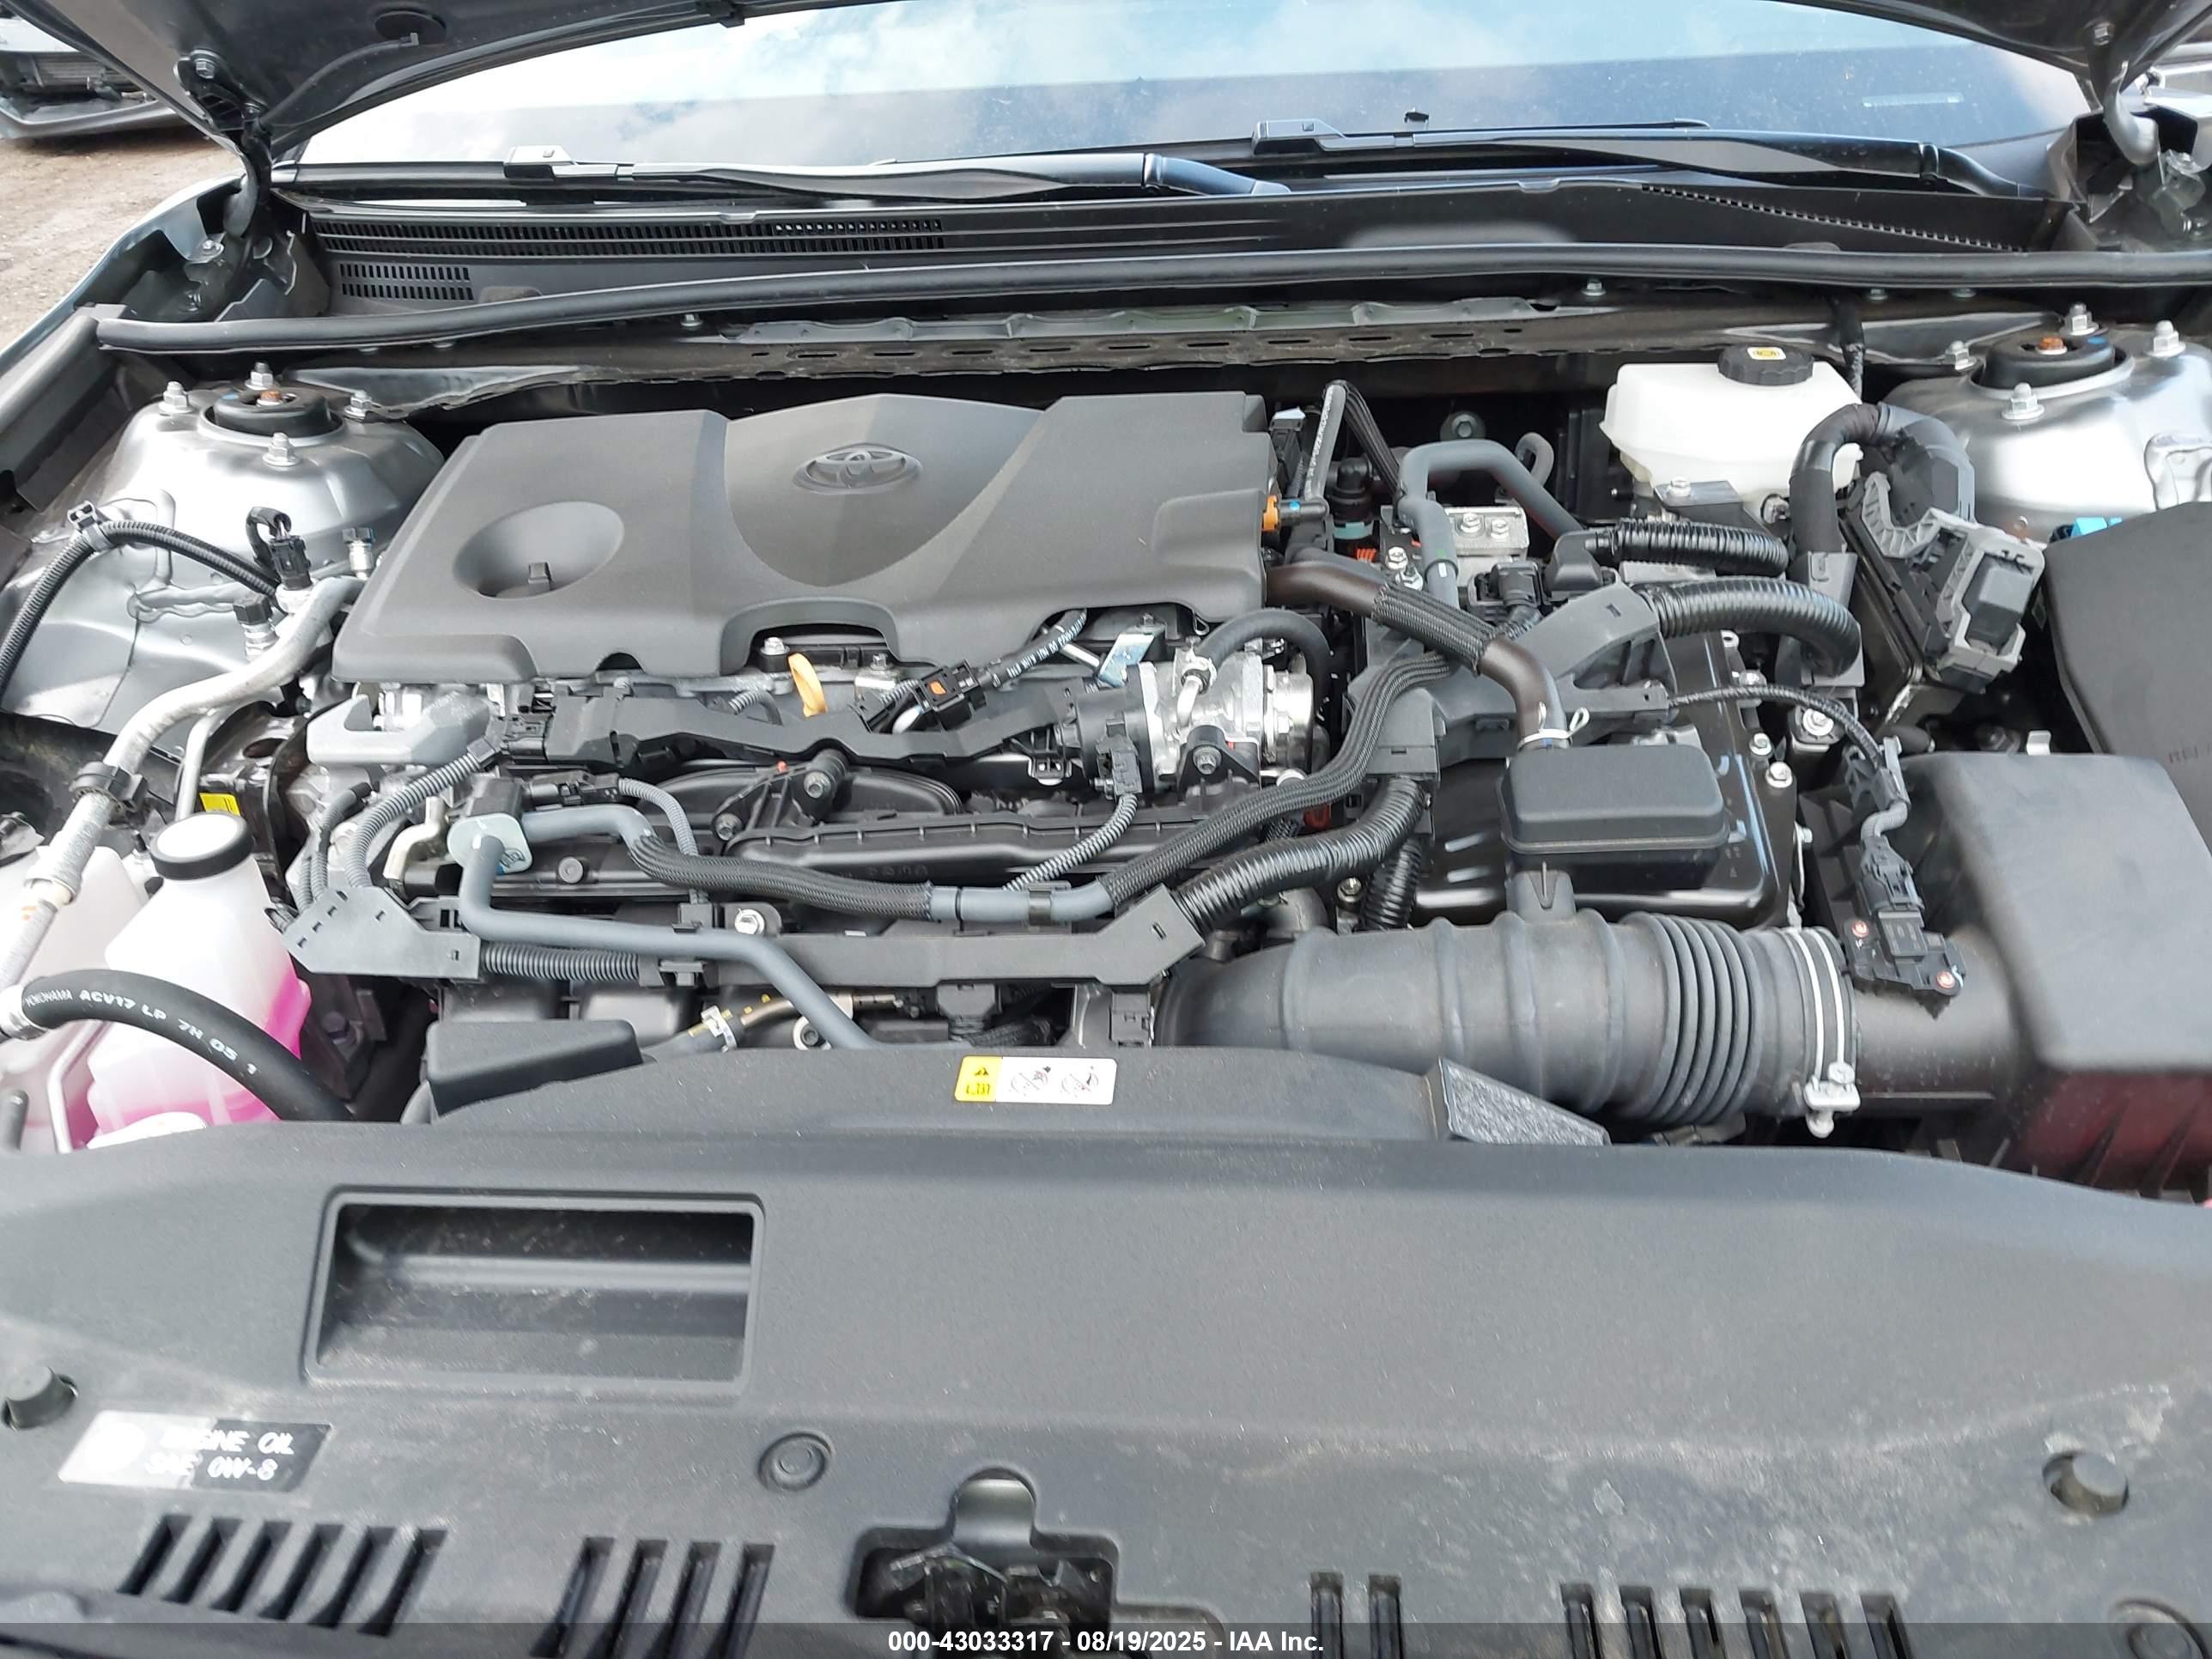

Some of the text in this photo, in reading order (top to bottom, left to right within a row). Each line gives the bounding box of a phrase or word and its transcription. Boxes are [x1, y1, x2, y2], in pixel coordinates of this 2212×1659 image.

[79, 989, 137, 1010] ACV17
[141, 1003, 167, 1020] LP
[257, 1431, 295, 1455] OIL
